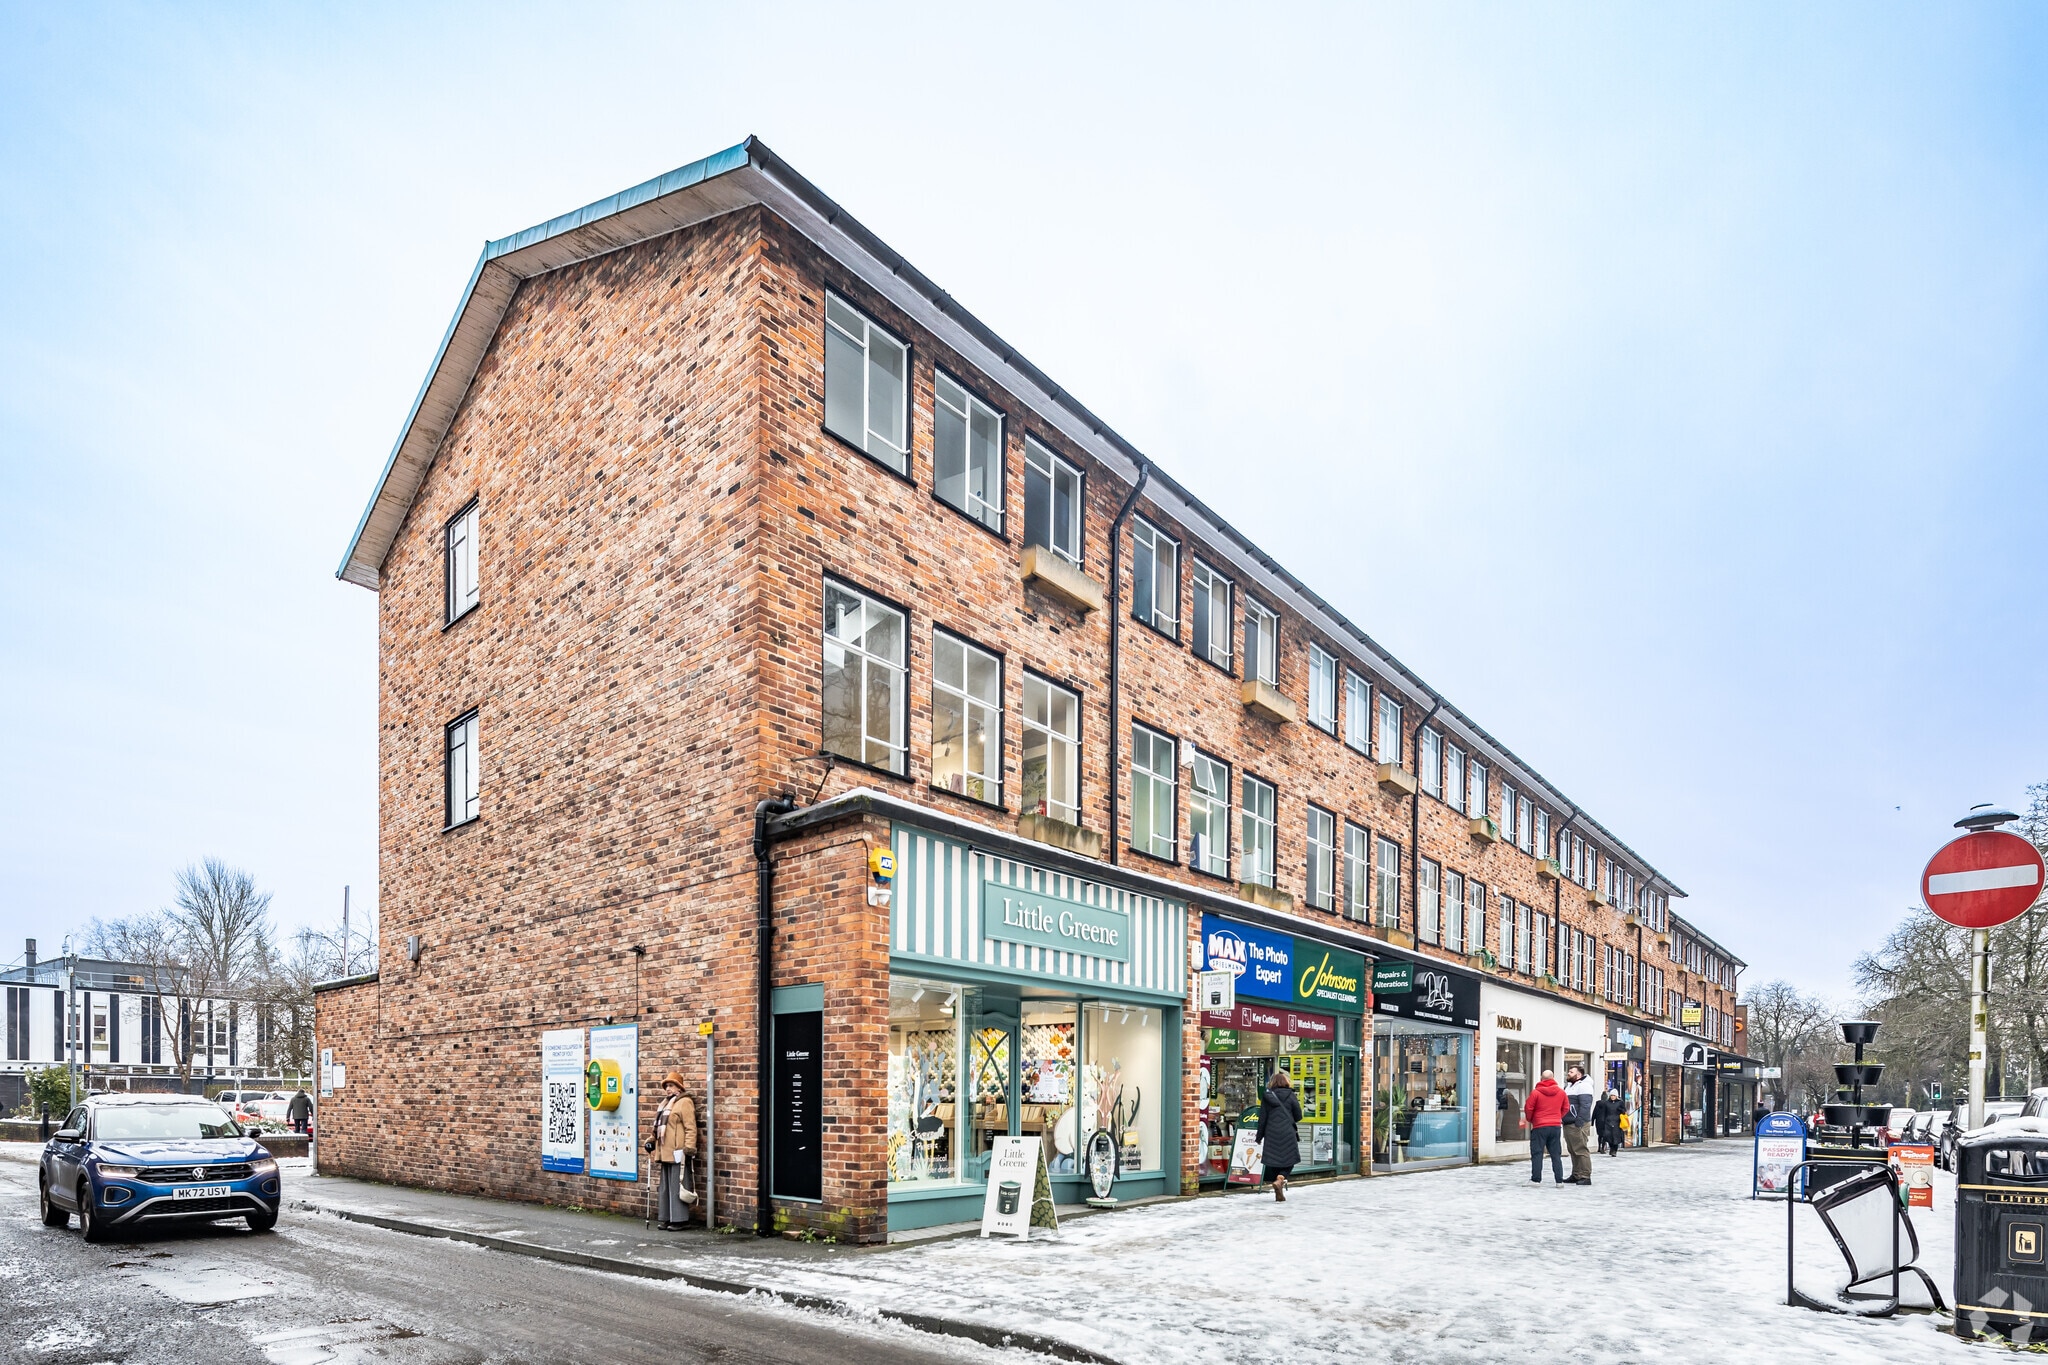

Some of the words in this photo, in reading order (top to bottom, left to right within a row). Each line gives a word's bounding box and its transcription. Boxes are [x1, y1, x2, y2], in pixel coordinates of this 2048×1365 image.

[881, 858, 892, 869] ADT
[1003, 898, 1053, 933] Little
[1058, 910, 1119, 946] Greene
[1208, 934, 1246, 962] MAX
[1249, 942, 1264, 960] The
[1265, 946, 1288, 966] Photo
[1212, 959, 1244, 972] SPIELMANN
[1255, 965, 1282, 985] Expert
[1299, 952, 1357, 998] Johnsons
[1377, 971, 1400, 979] Repairs
[1374, 980, 1408, 988] Alterations
[1316, 988, 1338, 1000] SPECIALIST
[1338, 992, 1357, 1004] CLEANING
[1252, 1013, 1262, 1024] Key
[1262, 1014, 1280, 1027] Cutting
[1297, 1019, 1311, 1029] Watch
[1311, 1021, 1327, 1031] Repairs
[1219, 1029, 1231, 1037] Key
[1214, 1037, 1236, 1046] Cutting
[1004, 1149, 1025, 1158] Little
[999, 1158, 1028, 1168] Greene
[178, 1188, 205, 1198] MK72
[207, 1186, 227, 1196] USV
